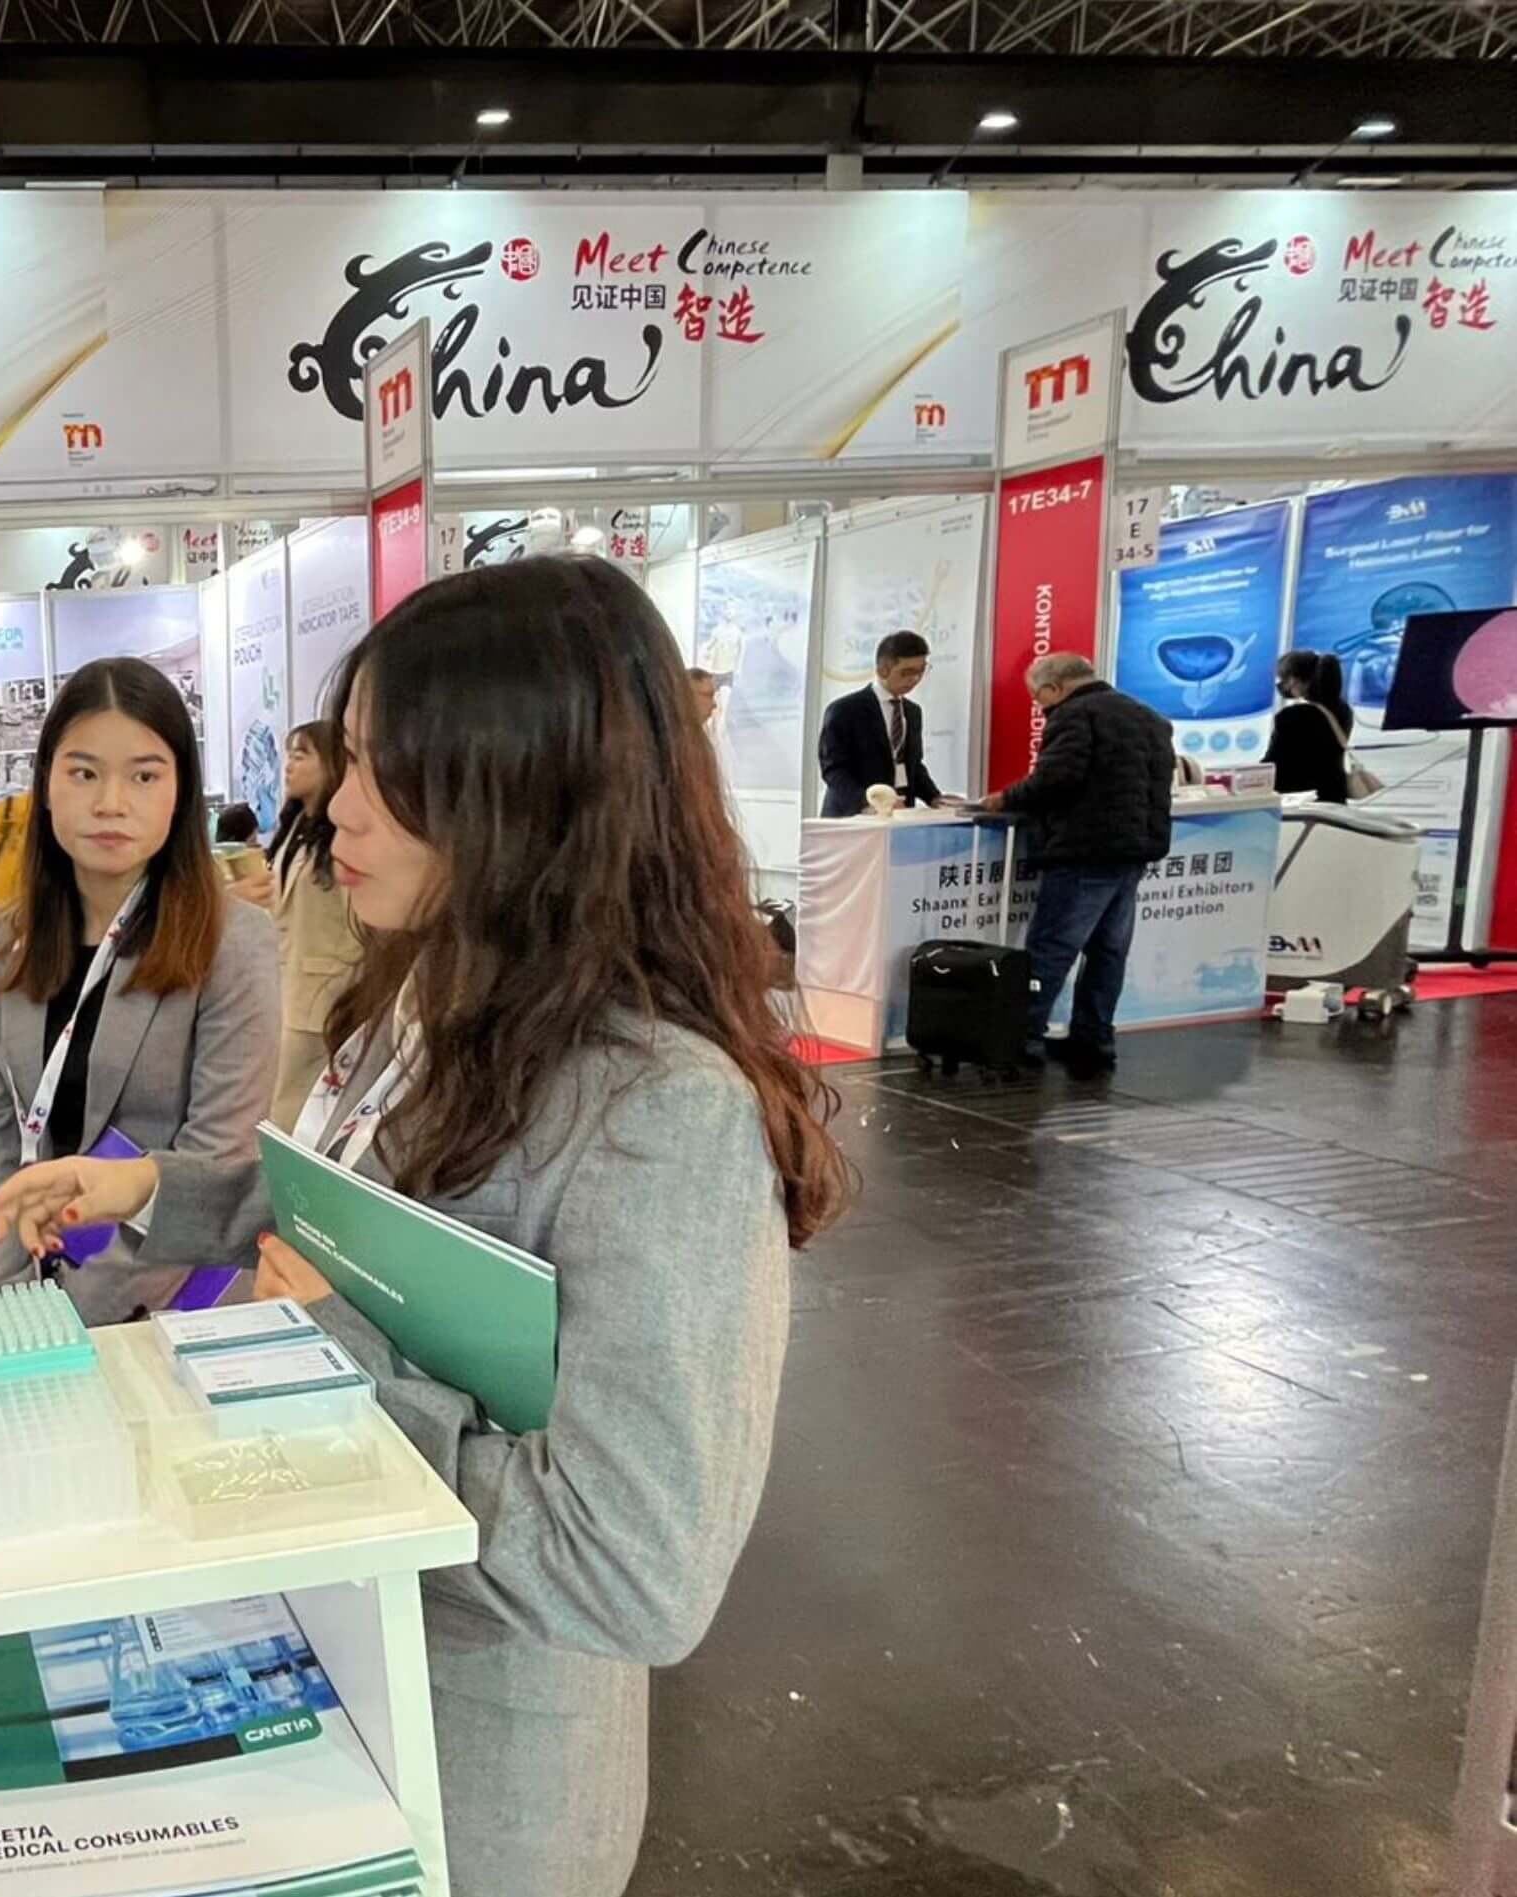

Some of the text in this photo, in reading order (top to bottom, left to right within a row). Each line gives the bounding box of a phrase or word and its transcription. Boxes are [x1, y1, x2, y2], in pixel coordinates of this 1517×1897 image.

[574, 232, 669, 280] Meet
[1343, 229, 1423, 273] Meet
[571, 283, 766, 343] 见证中国 智造
[1337, 276, 1497, 330] 见证中国 智造
[1126, 238, 1411, 402] China
[1009, 480, 1092, 515] 17E34-7
[1127, 498, 1148, 516] 17
[440, 527, 456, 545] 17
[1130, 523, 1141, 539] E
[444, 556, 452, 571] E
[1116, 543, 1154, 562] 34-5
[1177, 881, 1255, 898] Exhibitors
[912, 897, 967, 914] Shaanx
[1141, 902, 1225, 921] Delegation
[244, 1717, 314, 1743] CRETIA
[74, 1816, 240, 1851] CONSUMABLES
